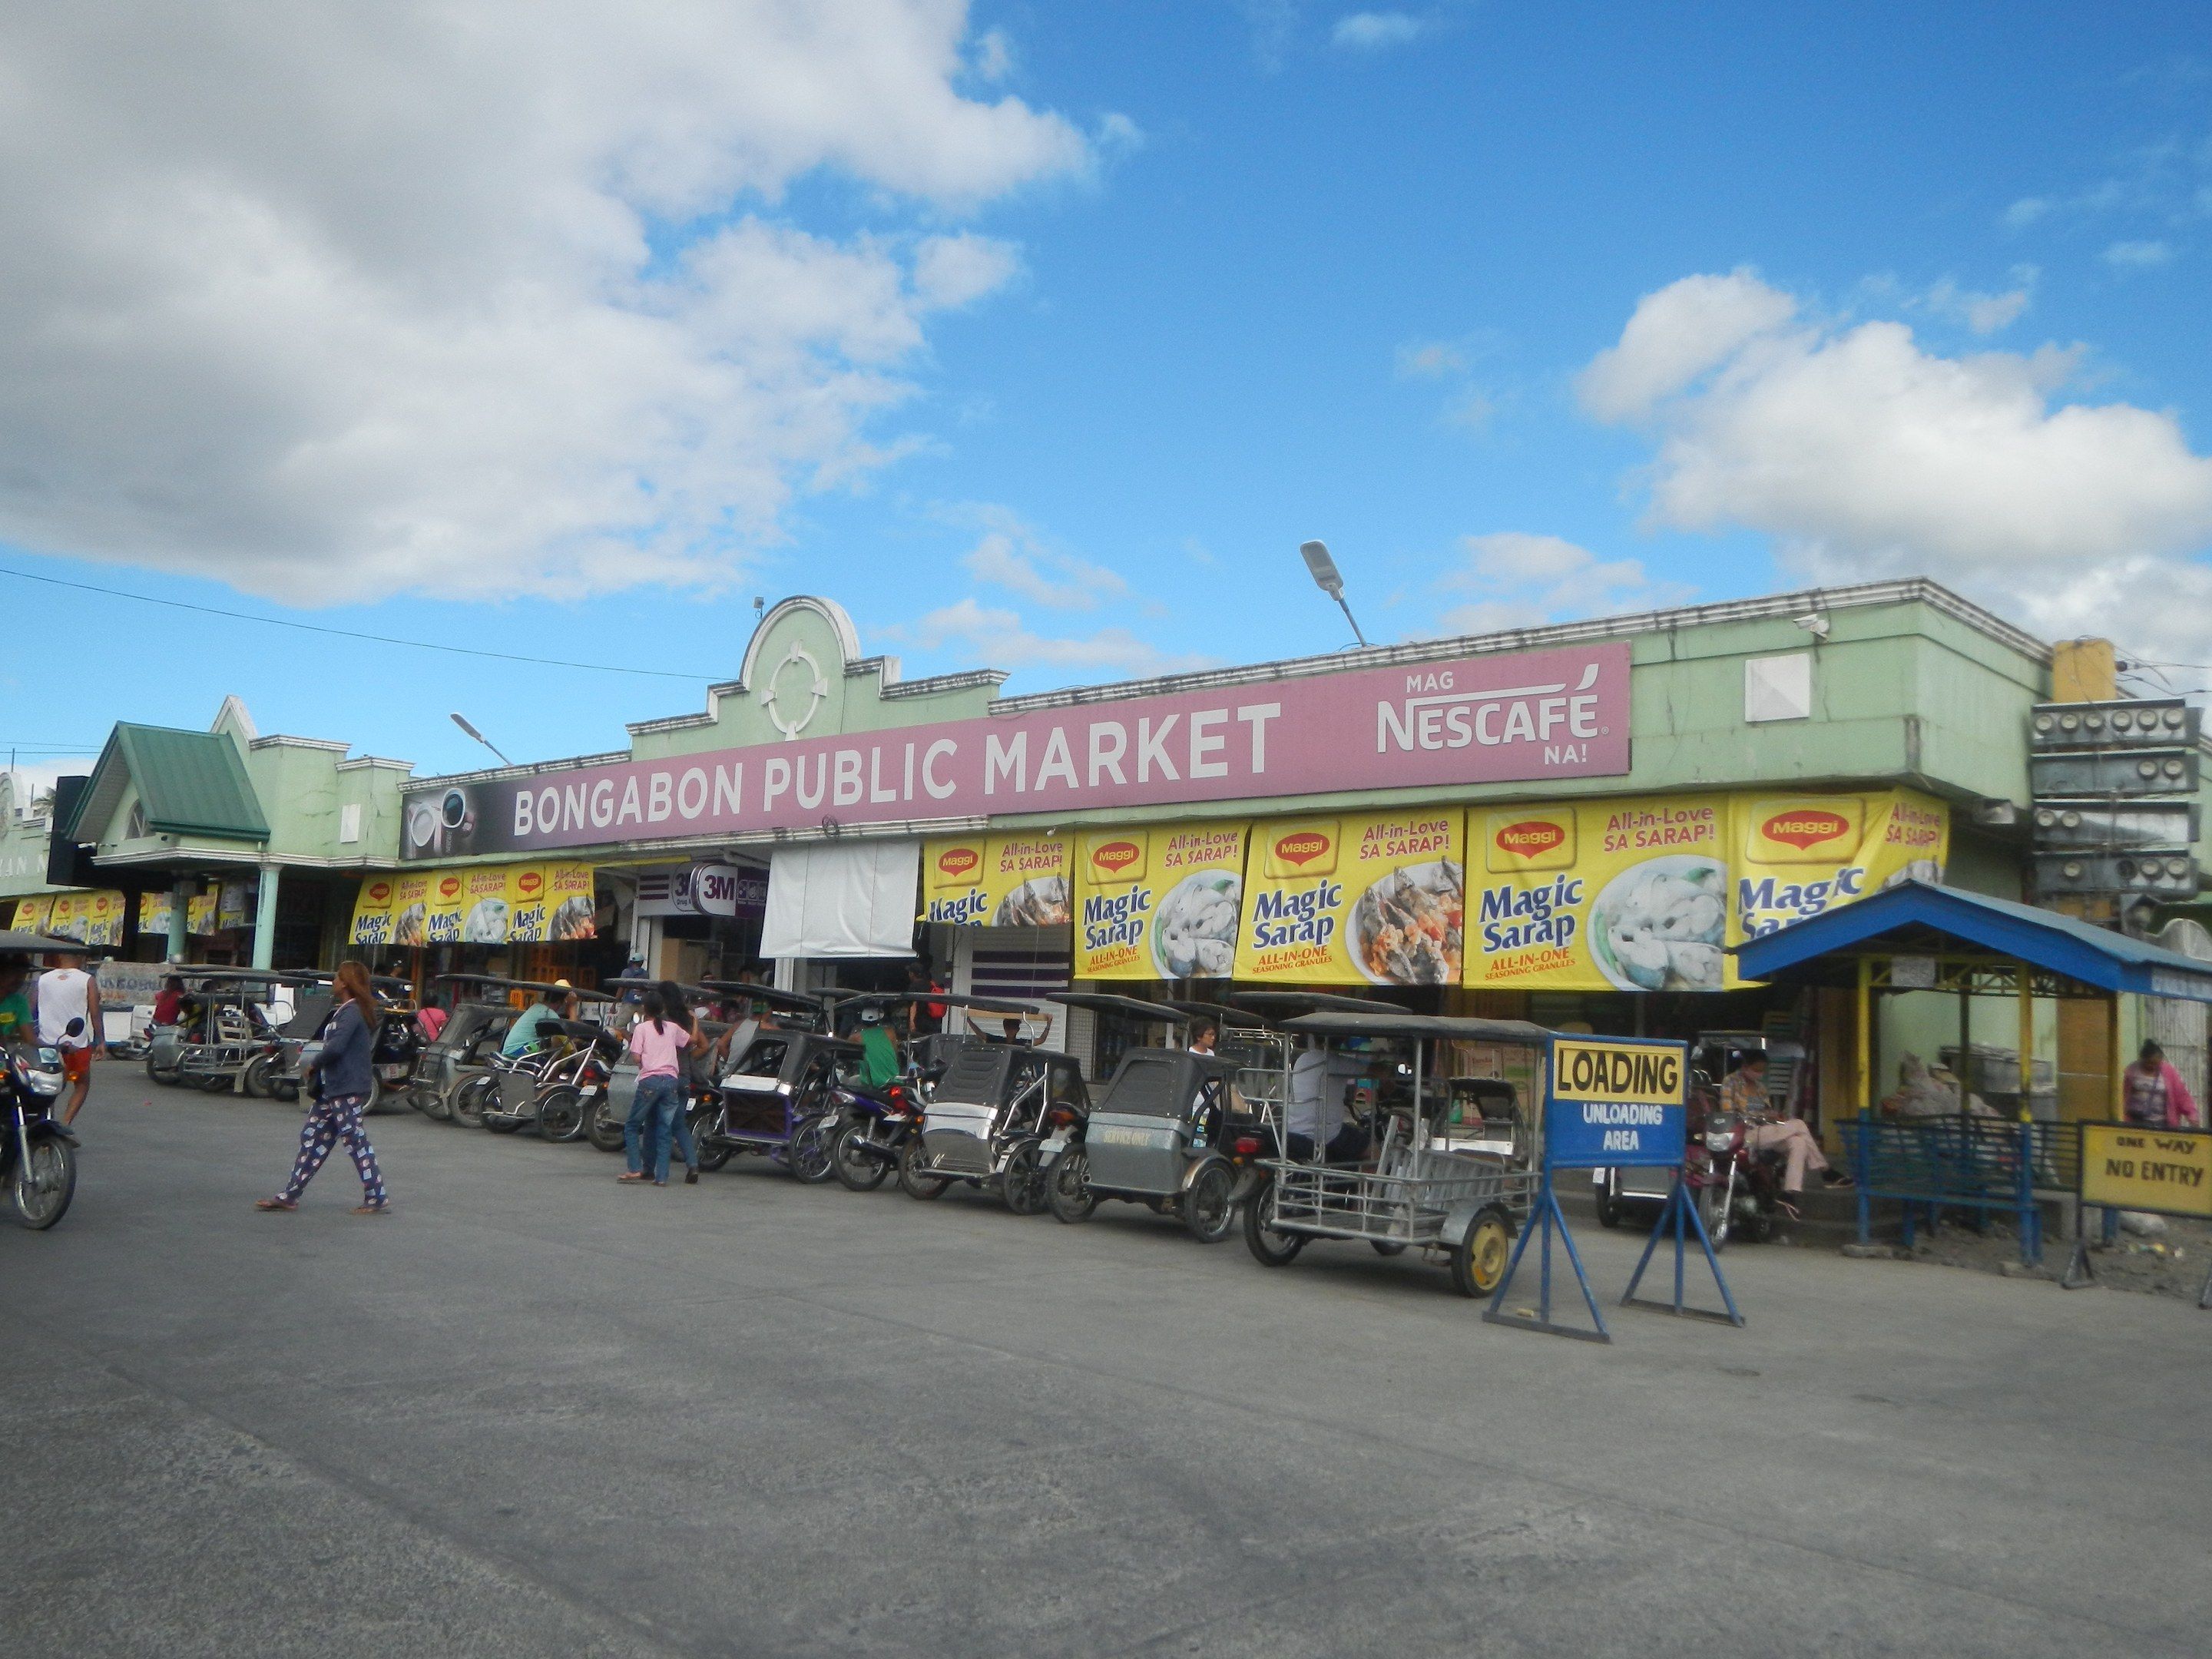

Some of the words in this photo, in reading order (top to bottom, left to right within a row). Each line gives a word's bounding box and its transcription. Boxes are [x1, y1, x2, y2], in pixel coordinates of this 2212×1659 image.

[1406, 671, 1454, 693] MAG
[1545, 744, 1587, 764] NA!
[514, 763, 743, 836] BONGABON
[764, 739, 958, 812] PUBLIC
[985, 703, 1281, 794] MARKET
[1607, 807, 1713, 833] All-in-Love
[1773, 820, 1839, 835] Maggi
[1167, 832, 1238, 851] All-in-Love
[1363, 820, 1449, 842] All-in-Love
[1504, 831, 1556, 845] Maggi
[1604, 834, 1628, 852] SA
[1635, 823, 1714, 849] SARAP!
[1886, 824, 1902, 843] SA
[1002, 841, 1063, 857] All-in-Love
[1099, 849, 1134, 861] Maggi
[1165, 853, 1183, 867] SA
[1187, 845, 1237, 865] SARAP!
[1281, 839, 1323, 854] Maggi
[1359, 844, 1380, 859] SA
[1386, 834, 1450, 856] SARAP!
[942, 855, 973, 866] Maggi
[1000, 859, 1014, 873] SA
[1018, 855, 1063, 871] SARAP!
[675, 873, 691, 896] 3
[703, 874, 735, 900] 3M
[1739, 868, 1864, 916] Magic
[1084, 885, 1151, 926] Magic
[1253, 879, 1342, 922] Magic
[1479, 874, 1583, 922] Magic
[356, 911, 392, 932] Magic
[1085, 919, 1144, 950] Sarap
[1253, 916, 1334, 949] Sarap
[1483, 915, 1575, 952] Sarap
[1087, 962, 1114, 973] SEASONING
[1114, 955, 1141, 969] GRANULES
[1090, 945, 1137, 966] ALL-IN-ONE
[1252, 961, 1293, 974] SEASONING
[1295, 955, 1333, 968] GRANULES
[1258, 945, 1327, 965] ALL-IN-ONE
[1491, 947, 1569, 971] ALL-IN-ONE
[1485, 965, 1531, 980] SEASONING
[1532, 959, 1575, 973] GRANULES
[1558, 1048, 1678, 1094] LOADING
[1583, 1104, 1663, 1124] UNLOADING
[1603, 1131, 1639, 1151] AREA
[2116, 1136, 2145, 1148] ONE
[2154, 1137, 2197, 1154] WAY
[2106, 1158, 2134, 1177] NO
[2141, 1161, 2204, 1187] ENTRY
